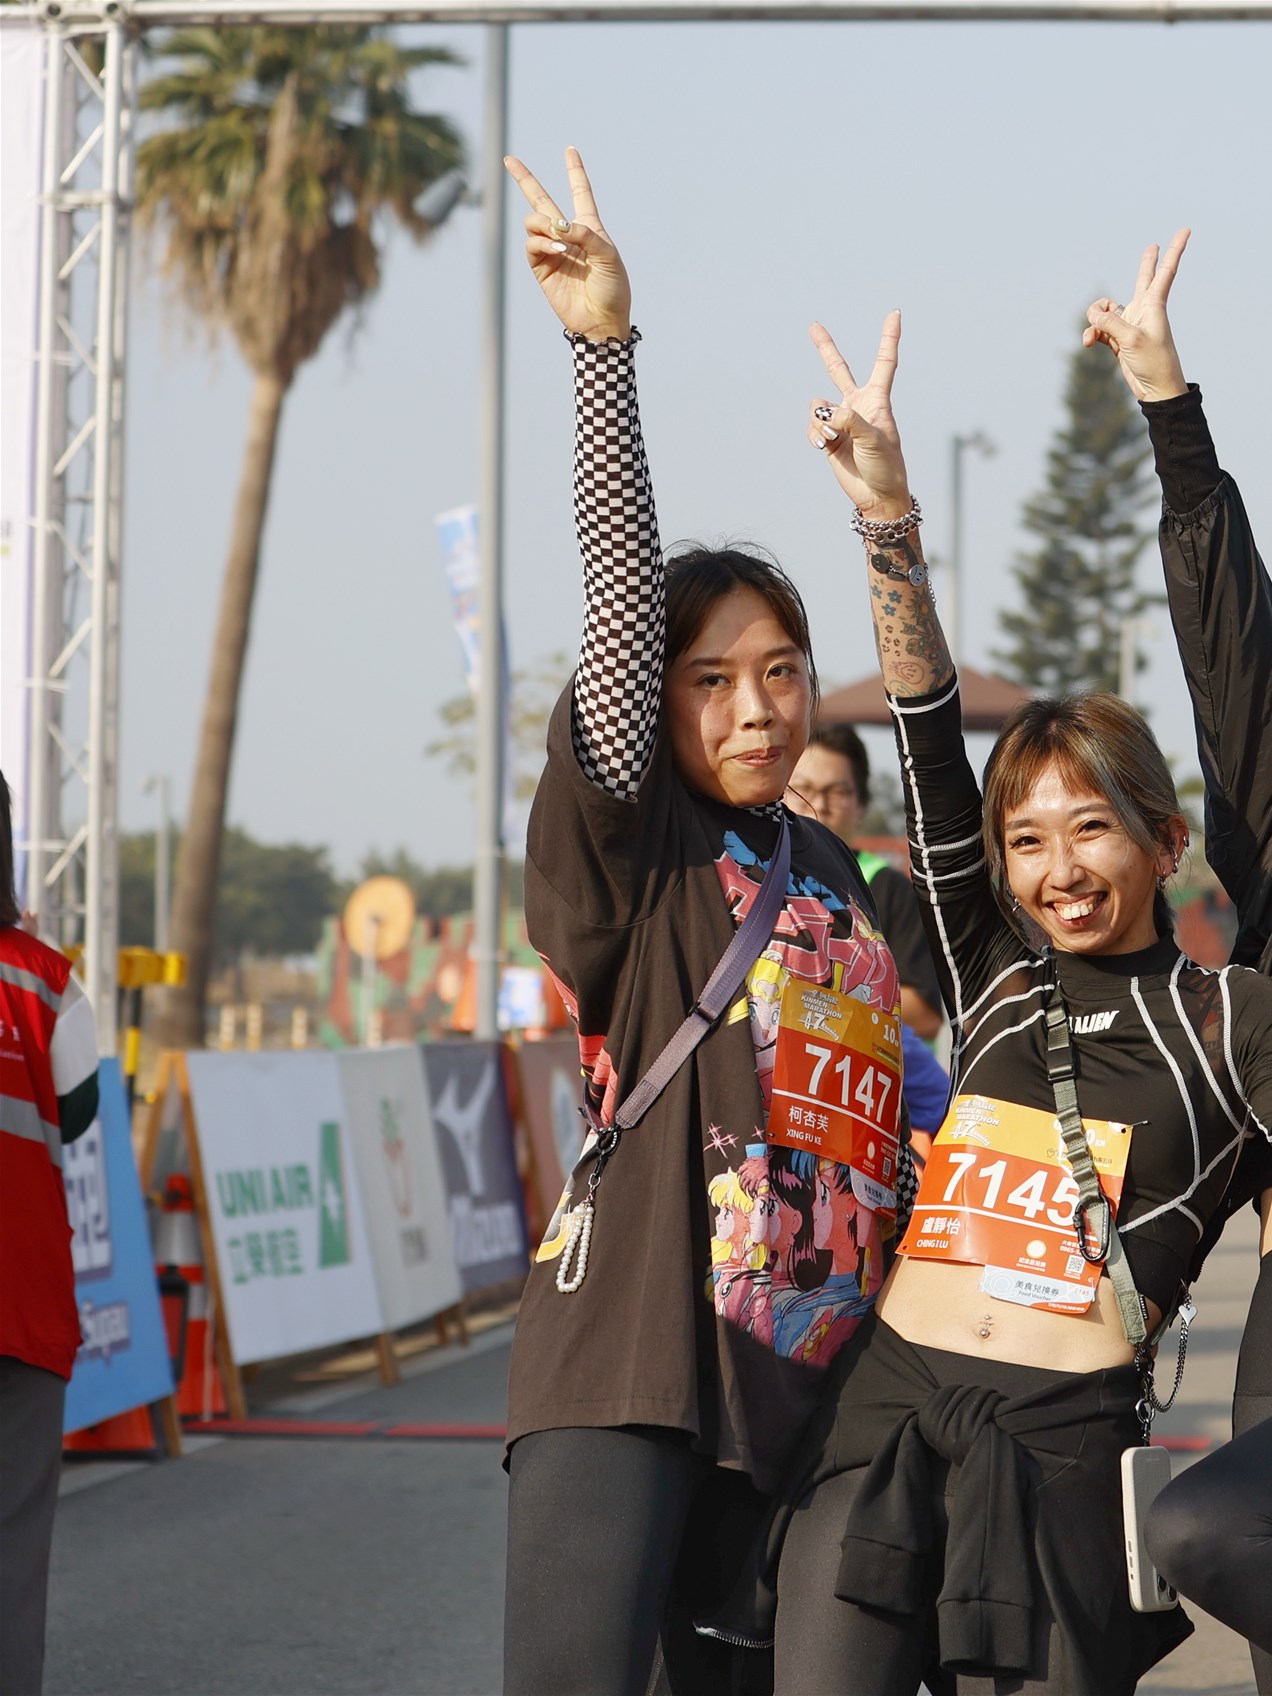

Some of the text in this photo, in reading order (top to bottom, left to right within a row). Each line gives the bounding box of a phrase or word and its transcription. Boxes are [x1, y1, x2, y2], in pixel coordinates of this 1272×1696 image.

[801, 995, 828, 1008] KINMEN
[804, 1003, 842, 1019] MARATHON
[1074, 1010, 1120, 1034] ALIEN
[804, 1042, 893, 1124] 7147
[788, 1105, 830, 1133] 柯杏芙
[956, 1113, 1000, 1127] MARATHON
[786, 1128, 822, 1145] XING FU KE
[216, 1164, 314, 1218] UNI AIR
[943, 1153, 1081, 1227] 7145
[916, 1239, 936, 1248] CHING
[939, 1240, 949, 1249] LU
[1018, 1290, 1051, 1301] Food Voucher
